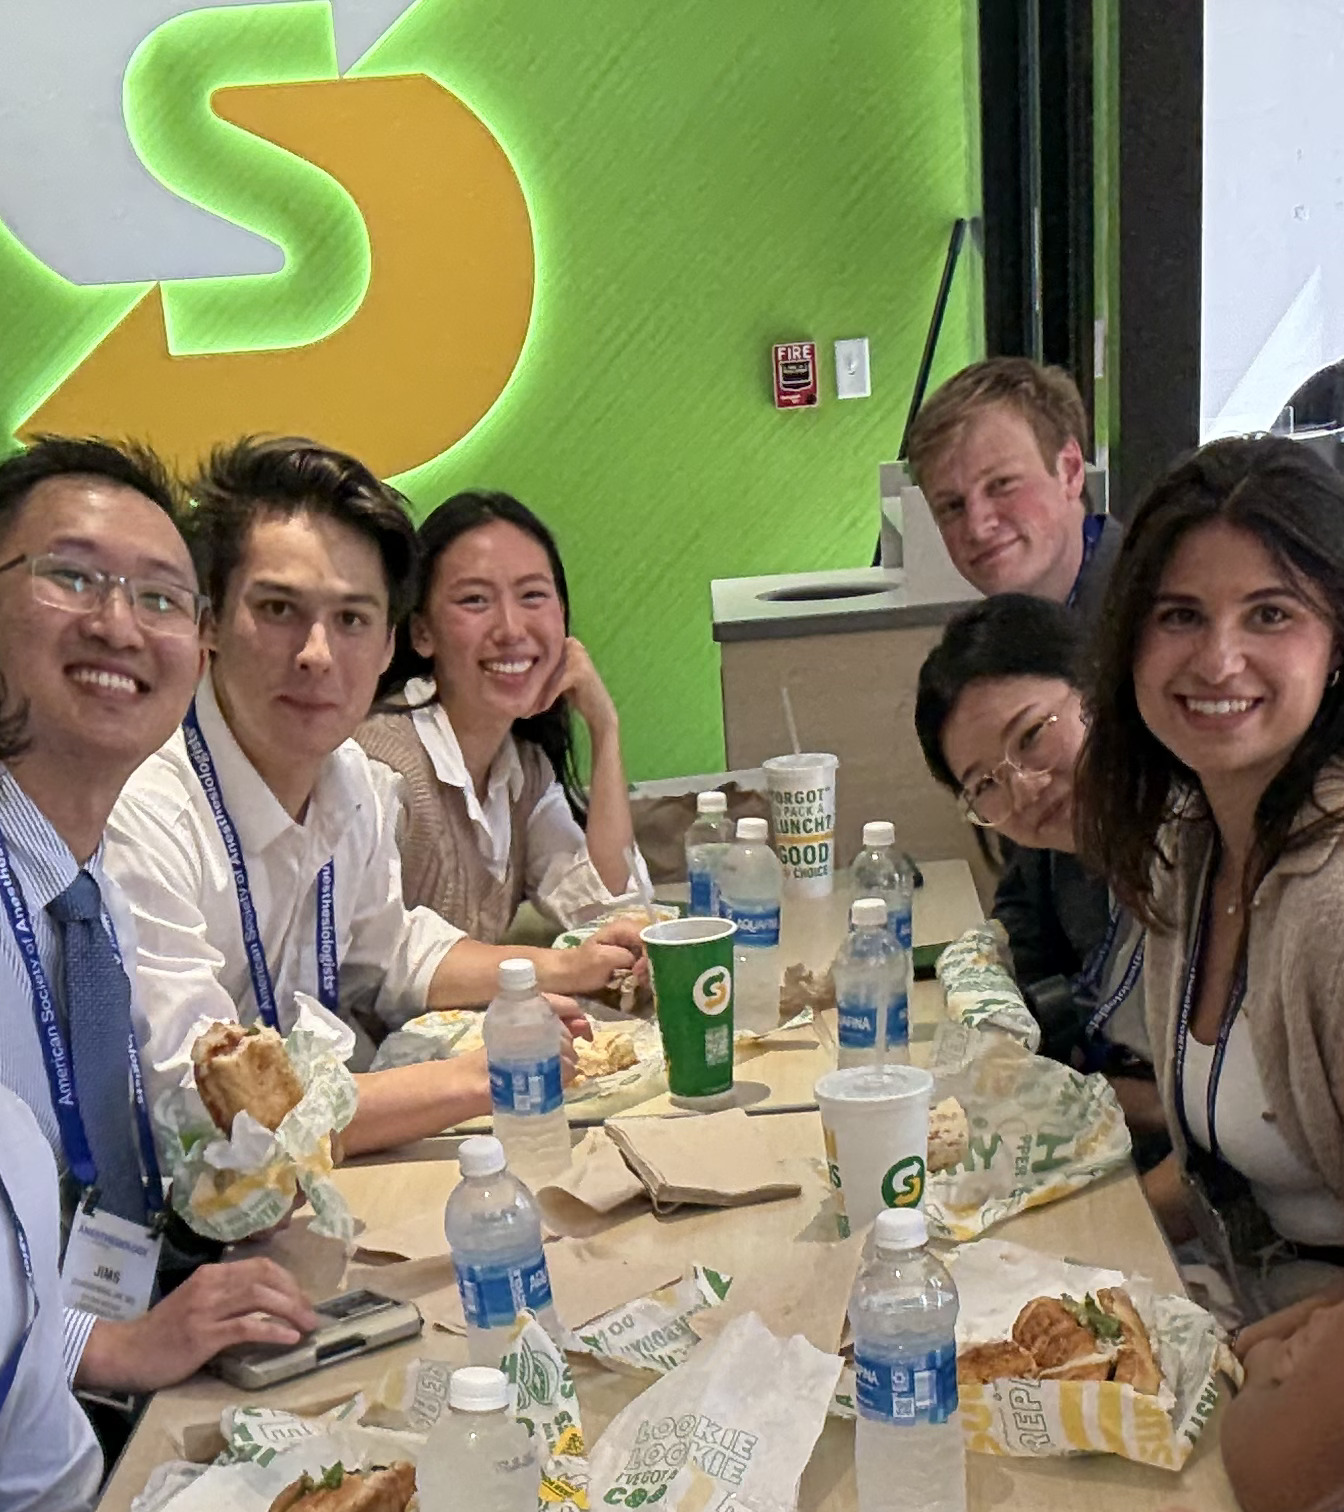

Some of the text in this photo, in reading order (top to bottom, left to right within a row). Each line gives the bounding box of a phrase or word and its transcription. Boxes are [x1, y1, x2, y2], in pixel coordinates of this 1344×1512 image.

[777, 345, 812, 360] FIRE
[779, 843, 829, 865] GOOD
[23, 938, 38, 957] of
[30, 959, 55, 1023] Society
[47, 1026, 74, 1106] American
[637, 1415, 758, 1459] LOOKIE
[626, 1437, 748, 1486] LOOKIE
